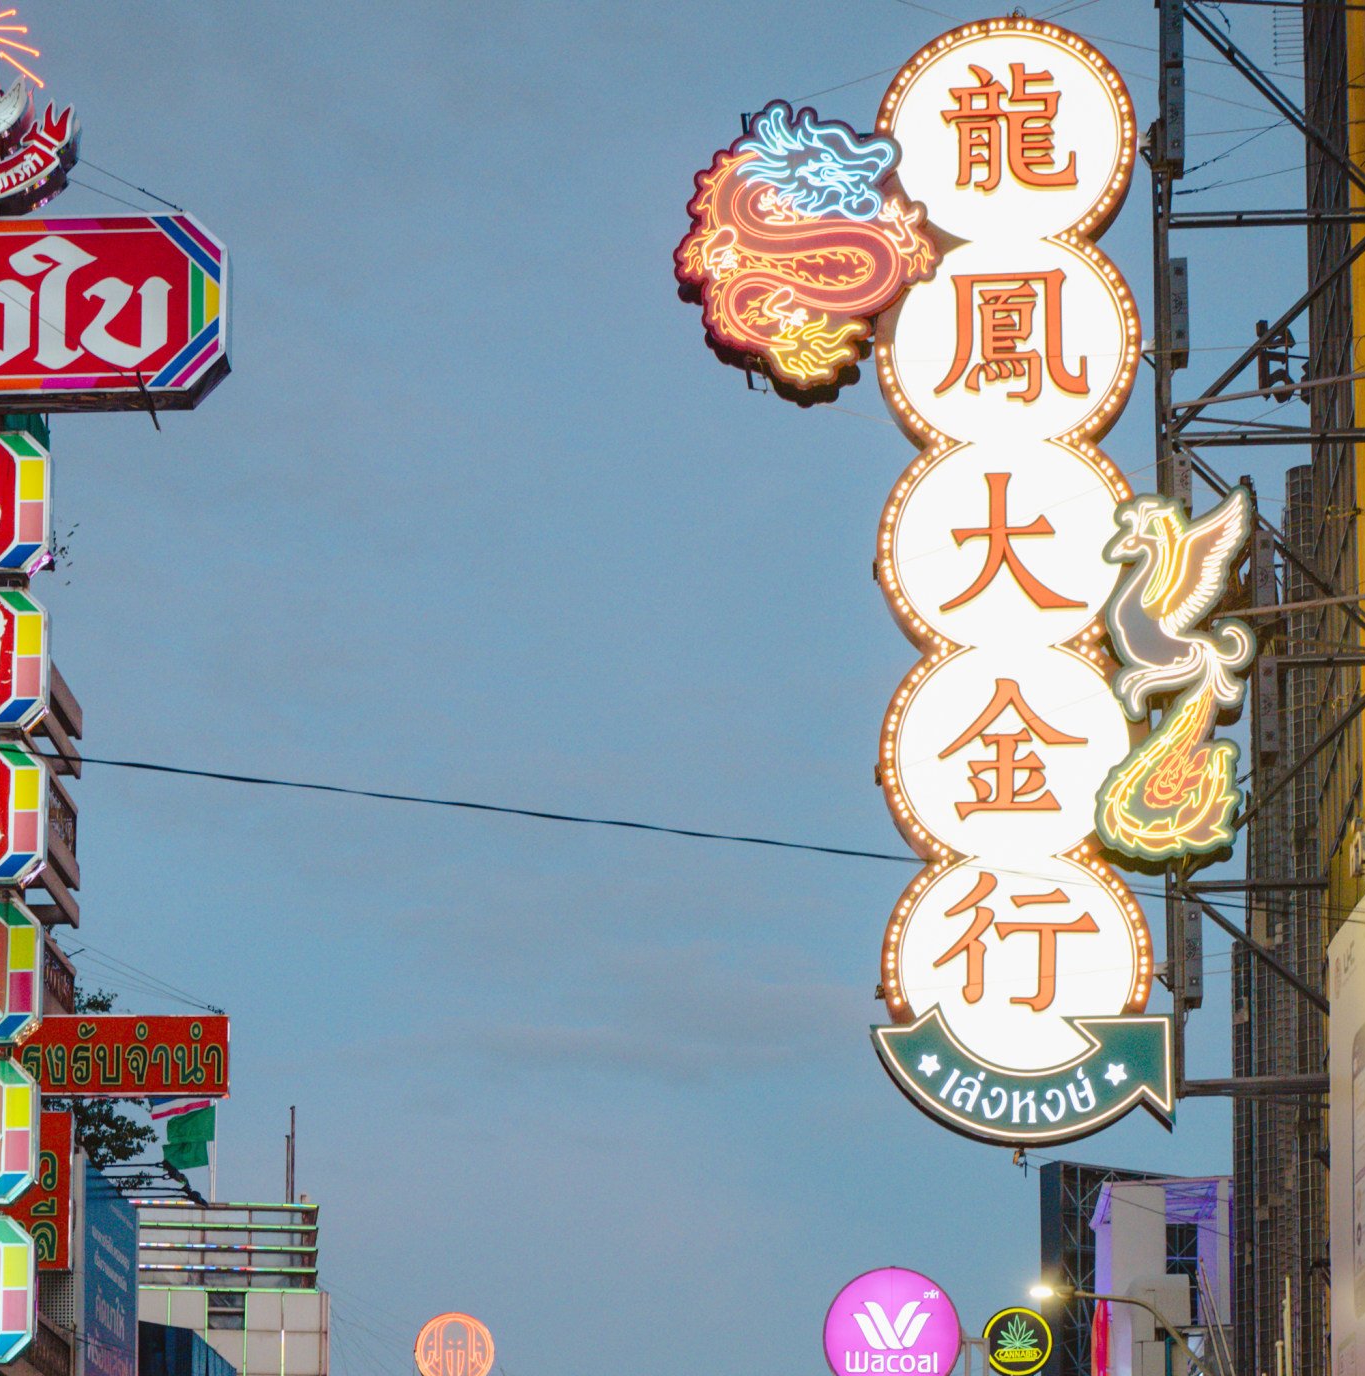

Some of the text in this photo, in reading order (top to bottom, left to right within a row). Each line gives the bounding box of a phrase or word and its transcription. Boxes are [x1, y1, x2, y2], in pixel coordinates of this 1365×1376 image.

[934, 62, 1099, 1011] 龍鳳大金行
[940, 1066, 1097, 1124] เล่งหงษ์
[845, 1350, 939, 1374] Wacoal
[999, 1350, 1038, 1360] CANNABIS
